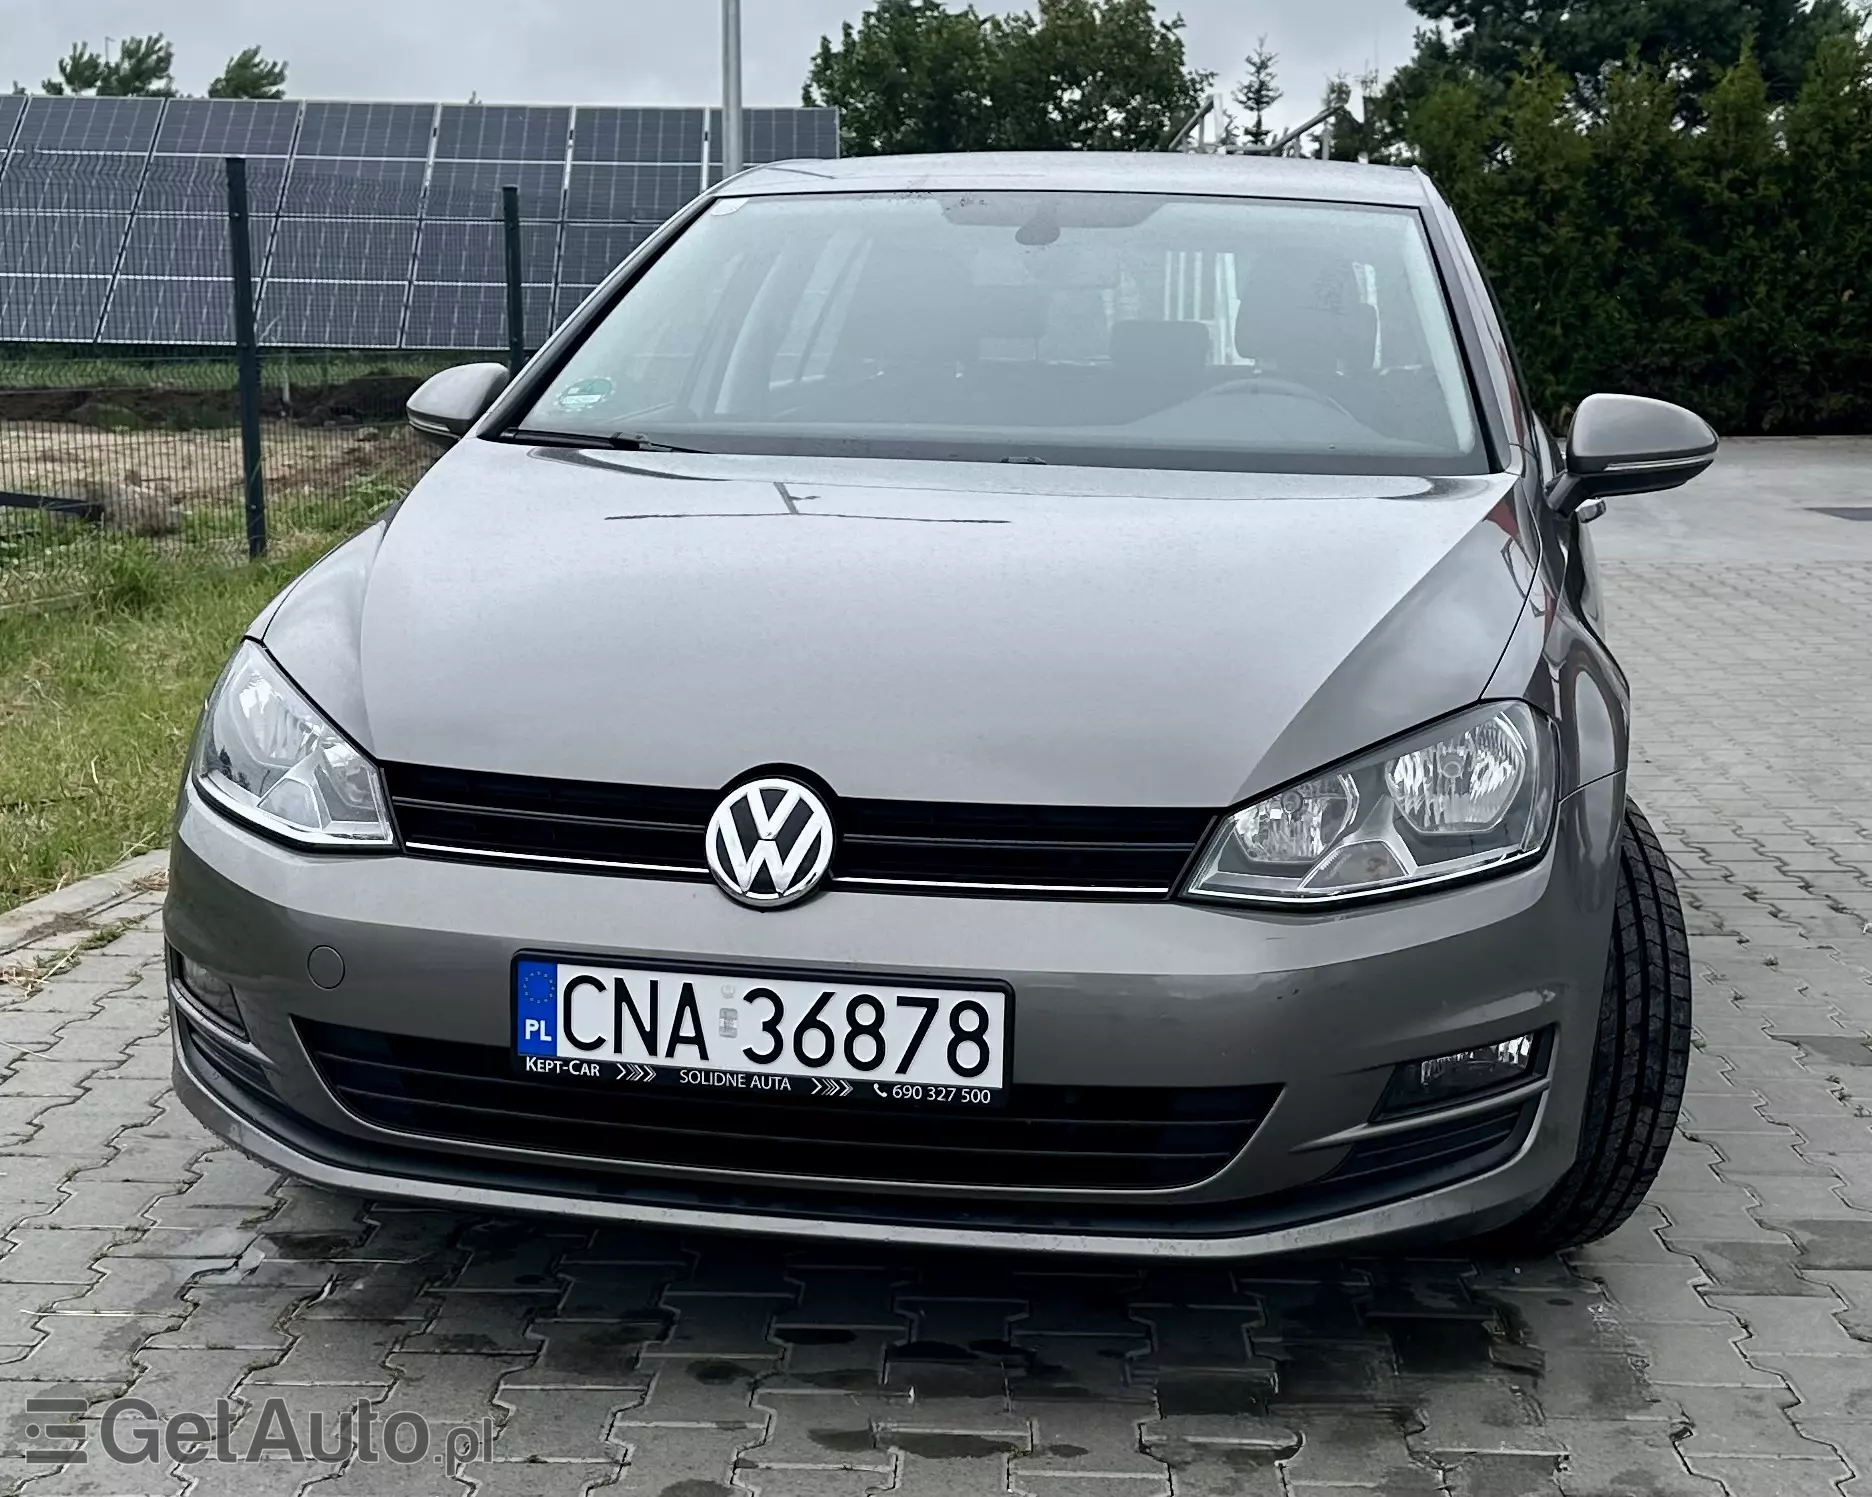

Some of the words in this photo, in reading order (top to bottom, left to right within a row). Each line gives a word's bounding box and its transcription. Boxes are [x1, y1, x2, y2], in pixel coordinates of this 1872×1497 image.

[525, 1018, 552, 1042] PL
[562, 974, 709, 1061] CNA
[742, 987, 990, 1078] 36878
[679, 1069, 746, 1088] SOLIDNE
[750, 1075, 792, 1091] AUTA
[892, 1084, 922, 1100] 690
[926, 1086, 956, 1102] 327
[961, 1088, 991, 1104] 500
